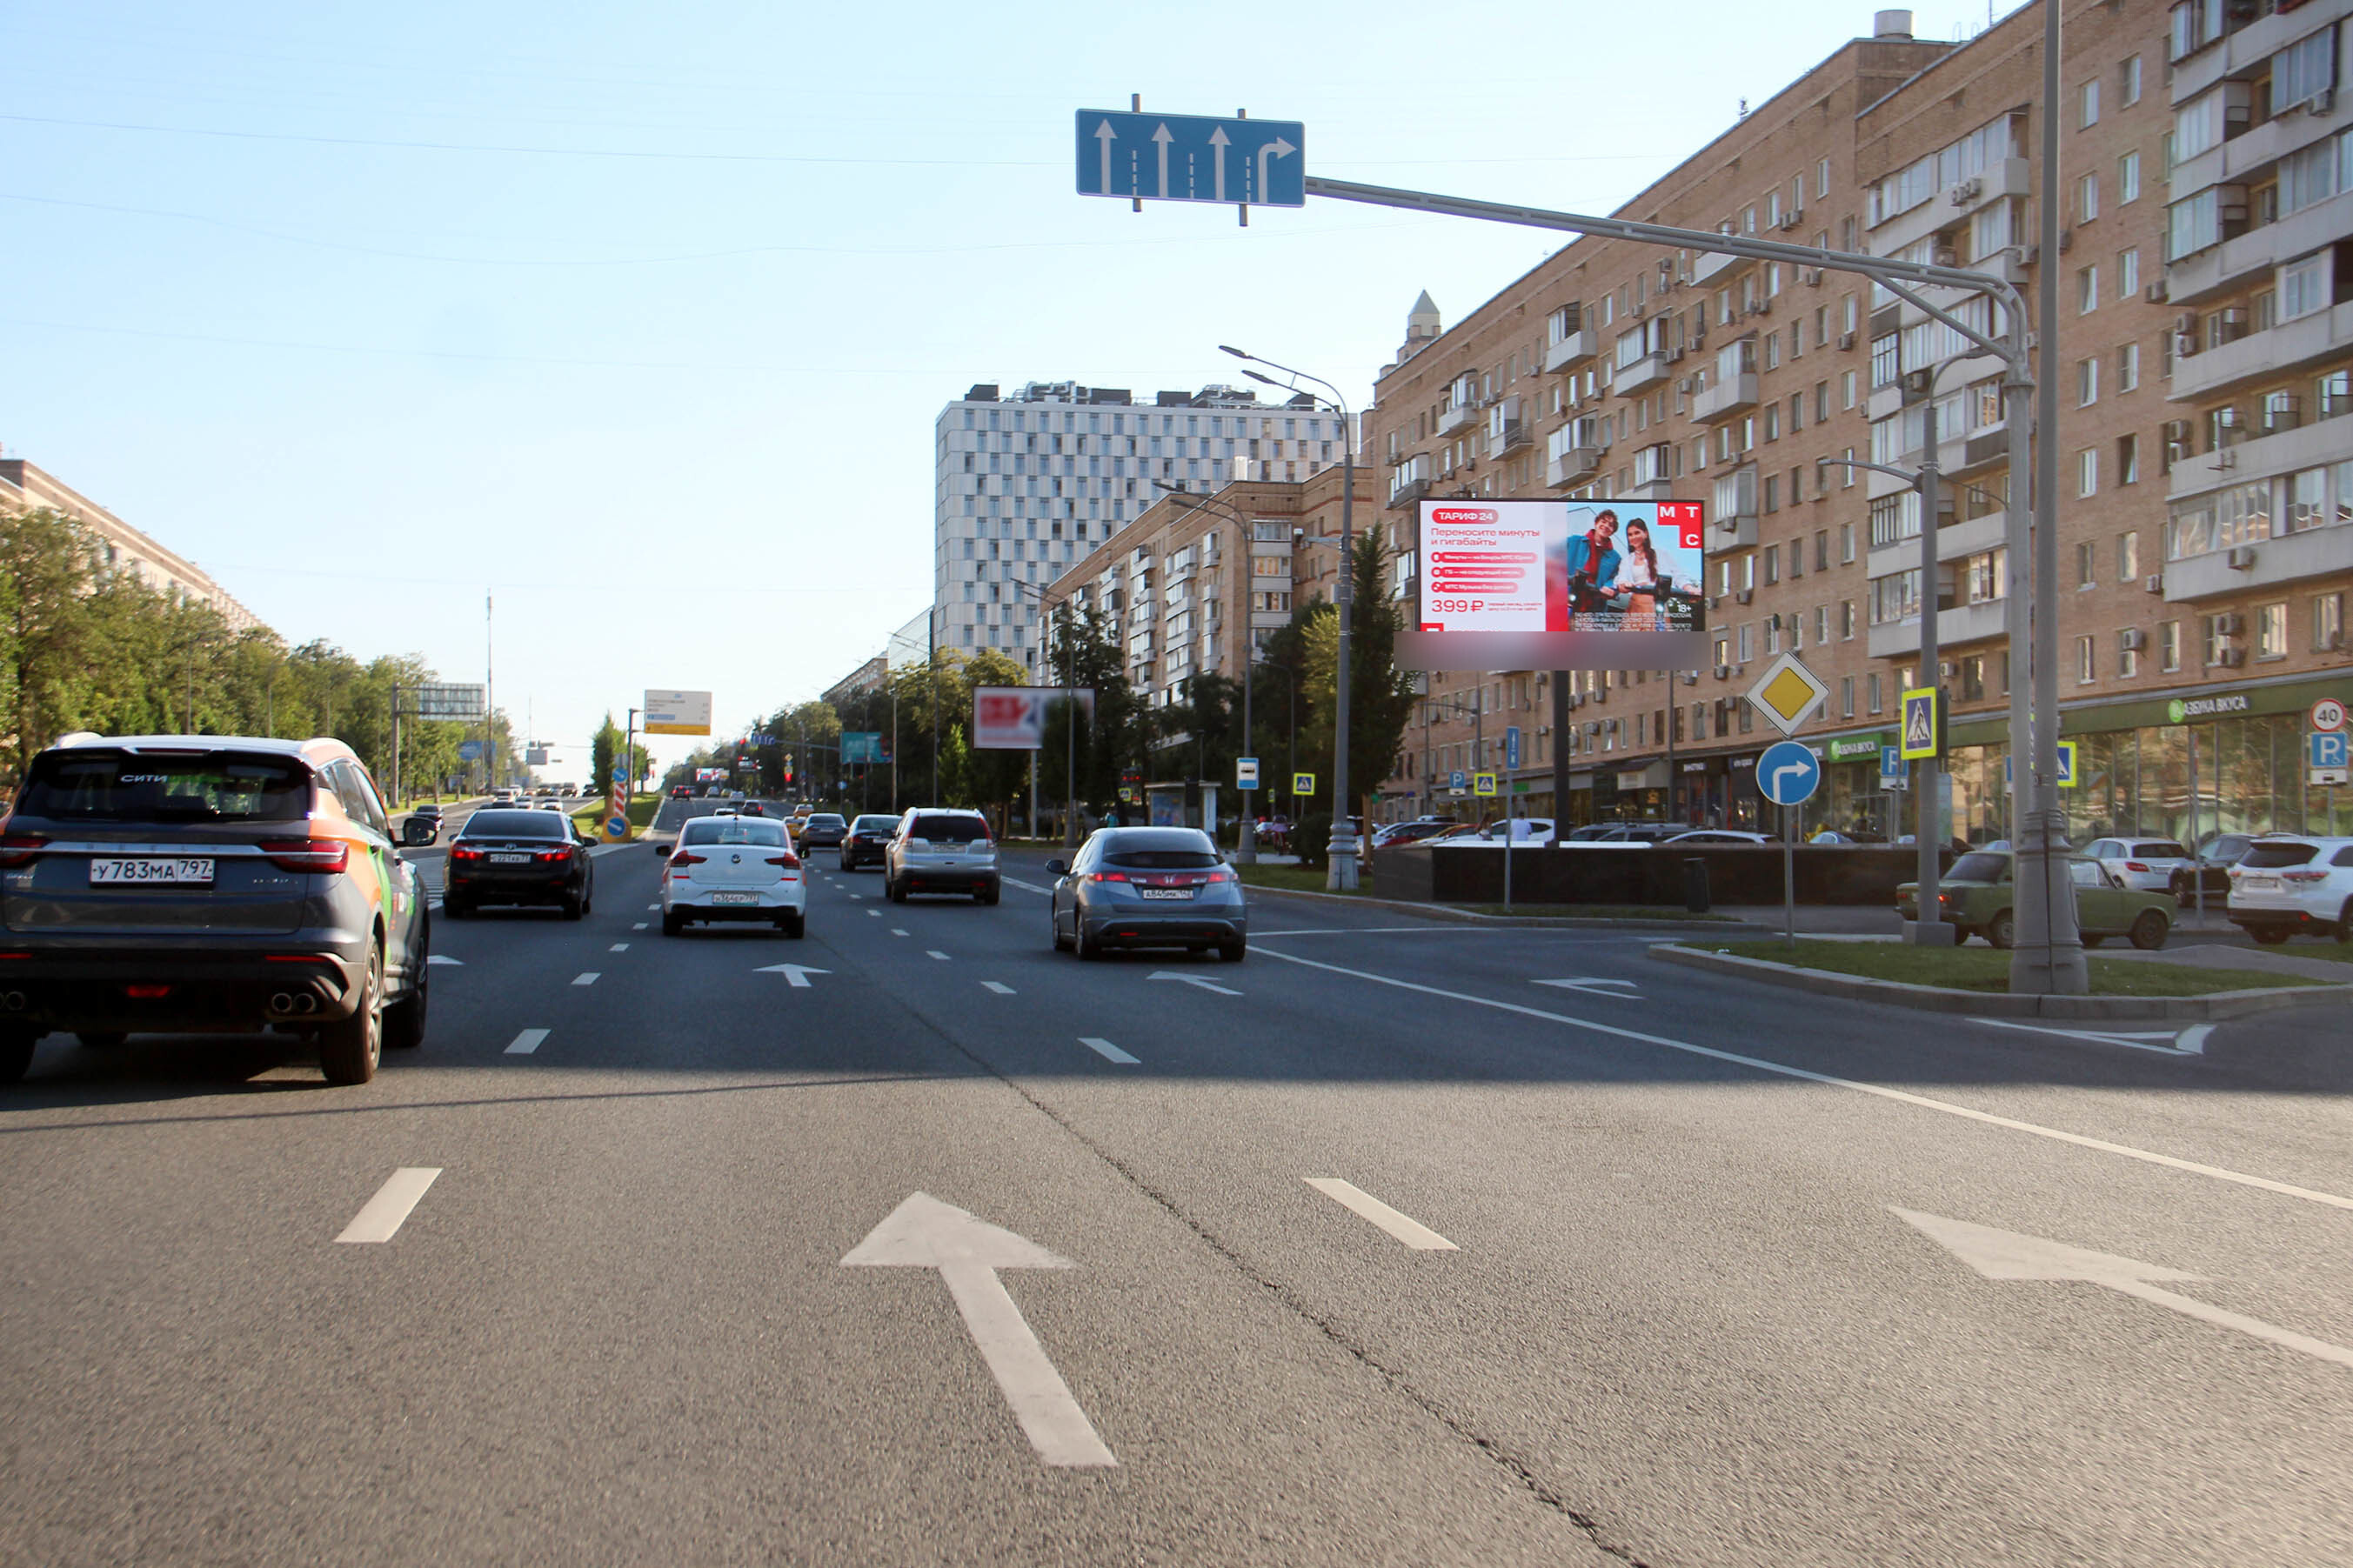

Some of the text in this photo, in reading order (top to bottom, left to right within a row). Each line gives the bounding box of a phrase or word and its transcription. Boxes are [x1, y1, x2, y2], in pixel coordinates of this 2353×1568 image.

[1438, 511, 1493, 521] ТАРИФ 24
[1430, 528, 1541, 538] Переносите минуты
[1440, 537, 1497, 546] гигабайты
[1432, 599, 1468, 612] 399
[2316, 708, 2338, 723] 40
[2320, 737, 2340, 764] P
[120, 774, 168, 783] СИТИ
[97, 860, 210, 879] У783МА 797
